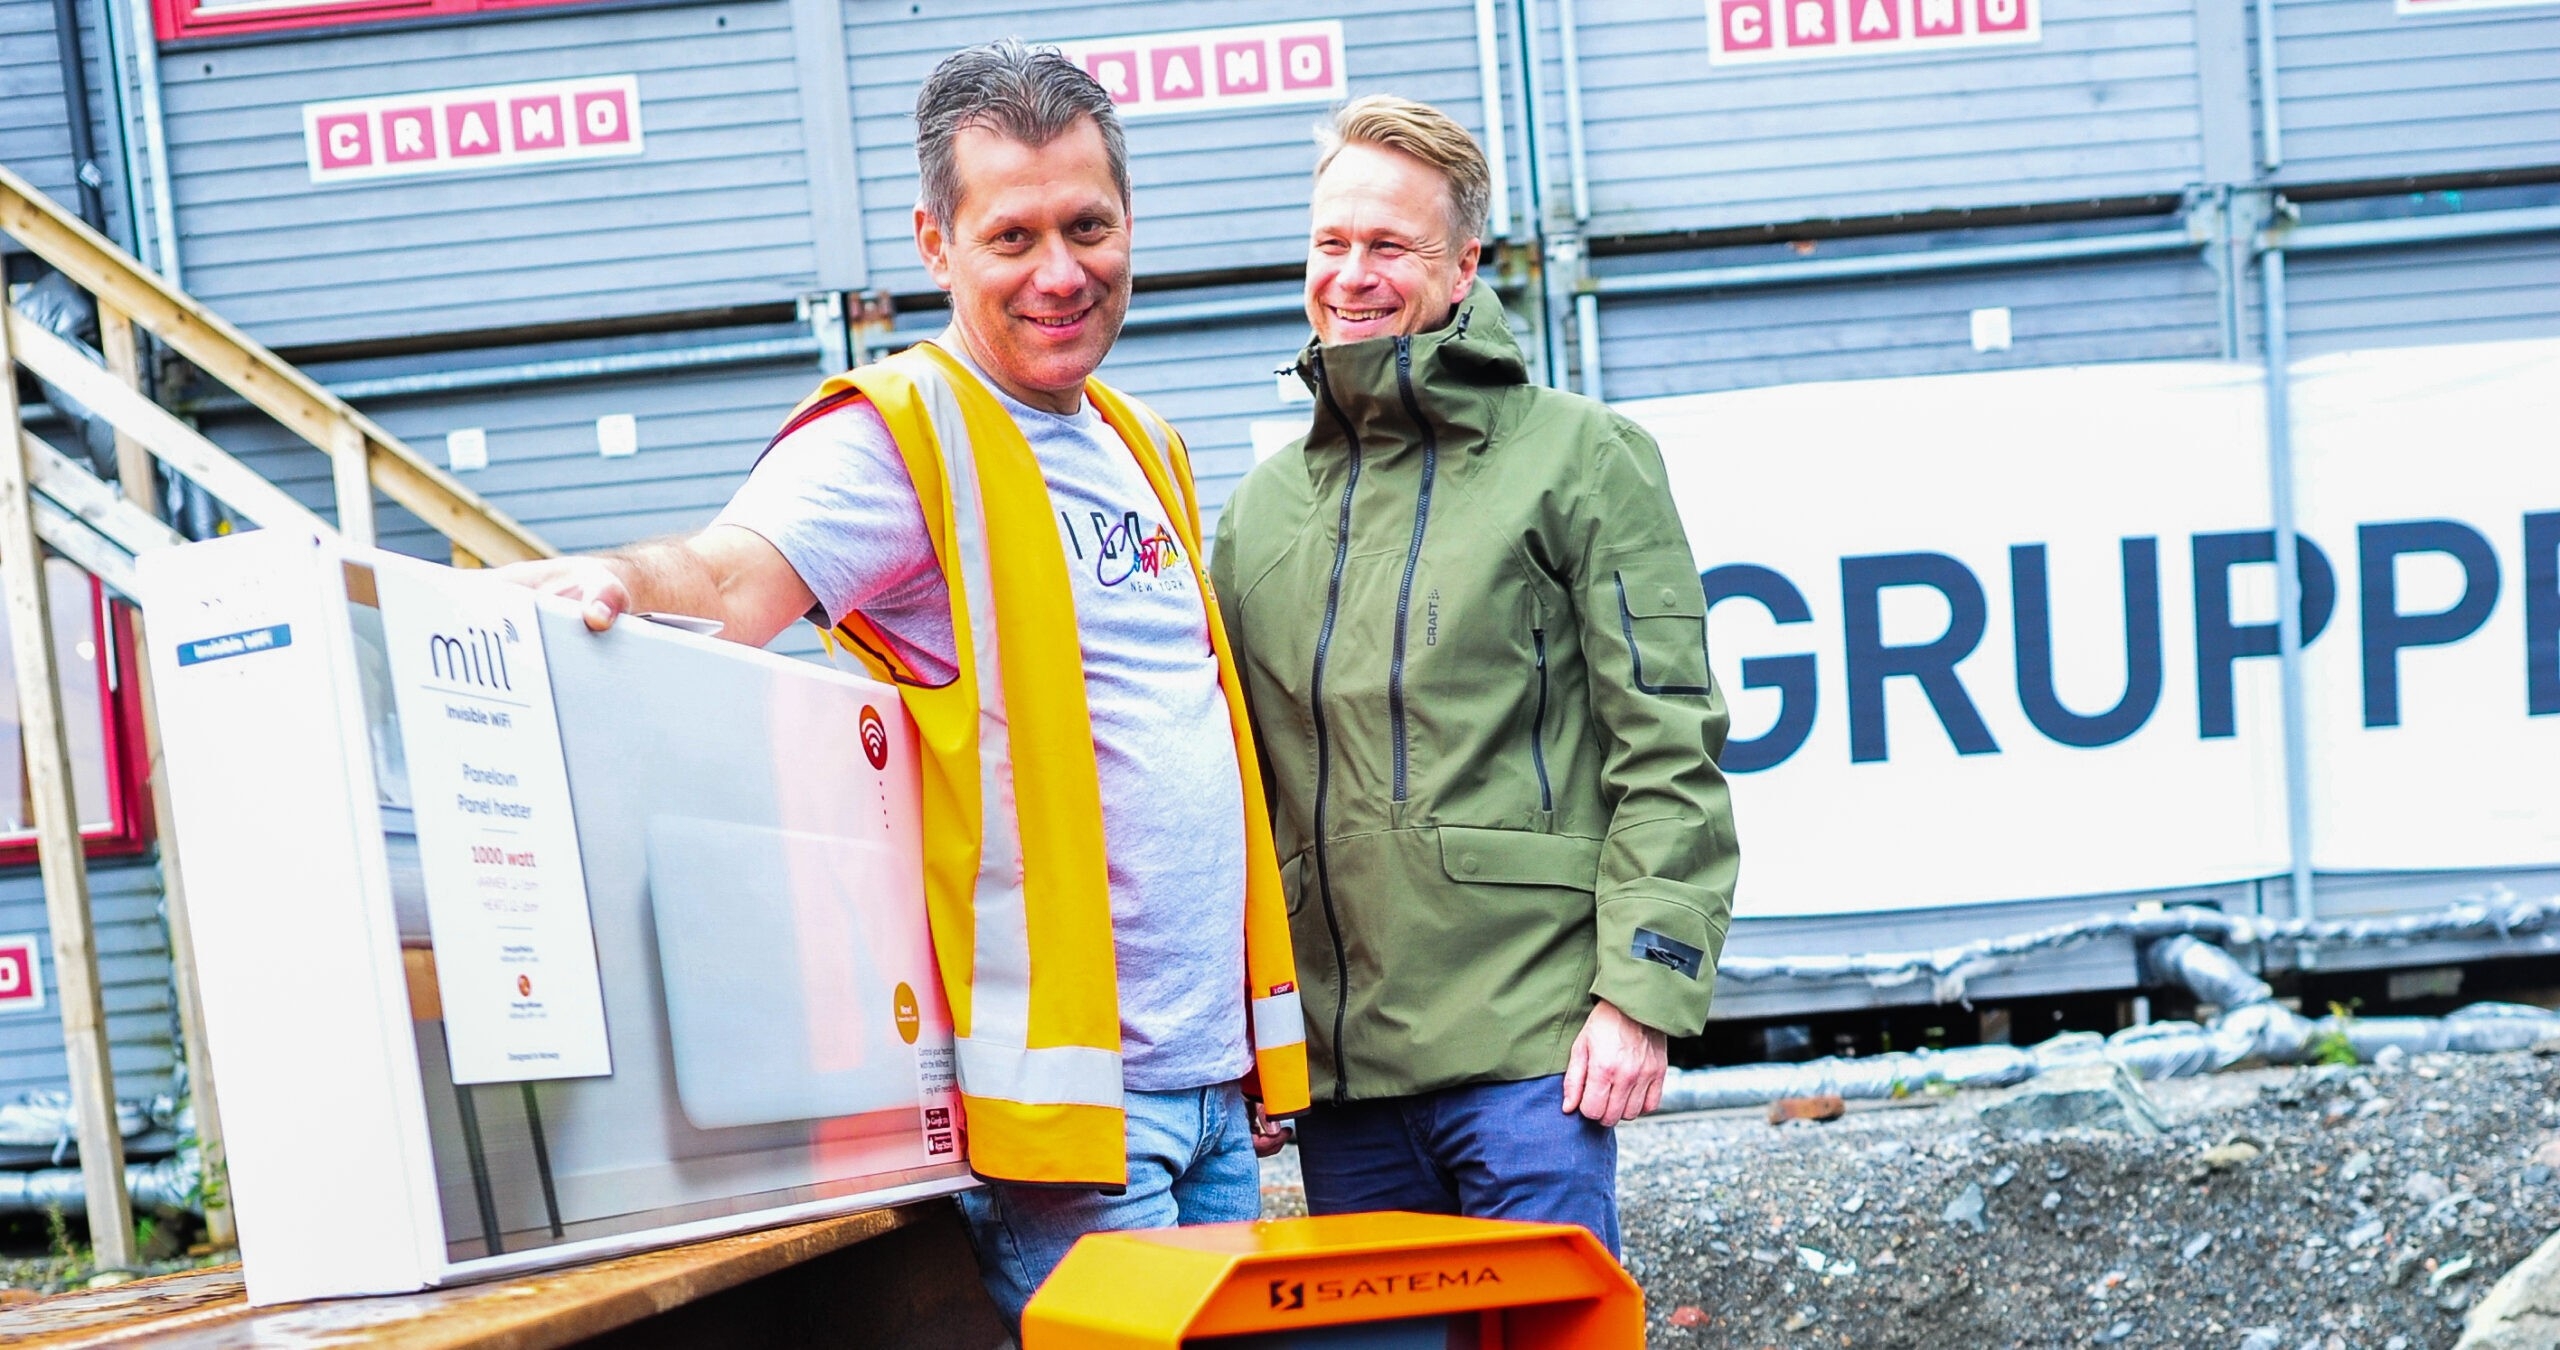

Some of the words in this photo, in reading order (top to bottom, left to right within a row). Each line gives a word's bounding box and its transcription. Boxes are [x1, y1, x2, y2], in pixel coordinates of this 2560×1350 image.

[1729, 0, 2018, 43] CRAMO
[1097, 44, 1323, 96] RAMO
[328, 98, 618, 161] CRAMO
[1130, 581, 1153, 593] NEW
[1159, 579, 1186, 592] YORK
[1427, 601, 1439, 646] CRAFT
[430, 627, 511, 692] mill
[444, 703, 489, 726] Invisible
[489, 710, 512, 729] WiFi
[462, 762, 519, 787] Panelovn
[457, 793, 493, 816] Panel
[492, 797, 532, 819] heater
[471, 845, 504, 866] 1000
[506, 852, 537, 868] watt
[1317, 1267, 1502, 1302] SATEMA
